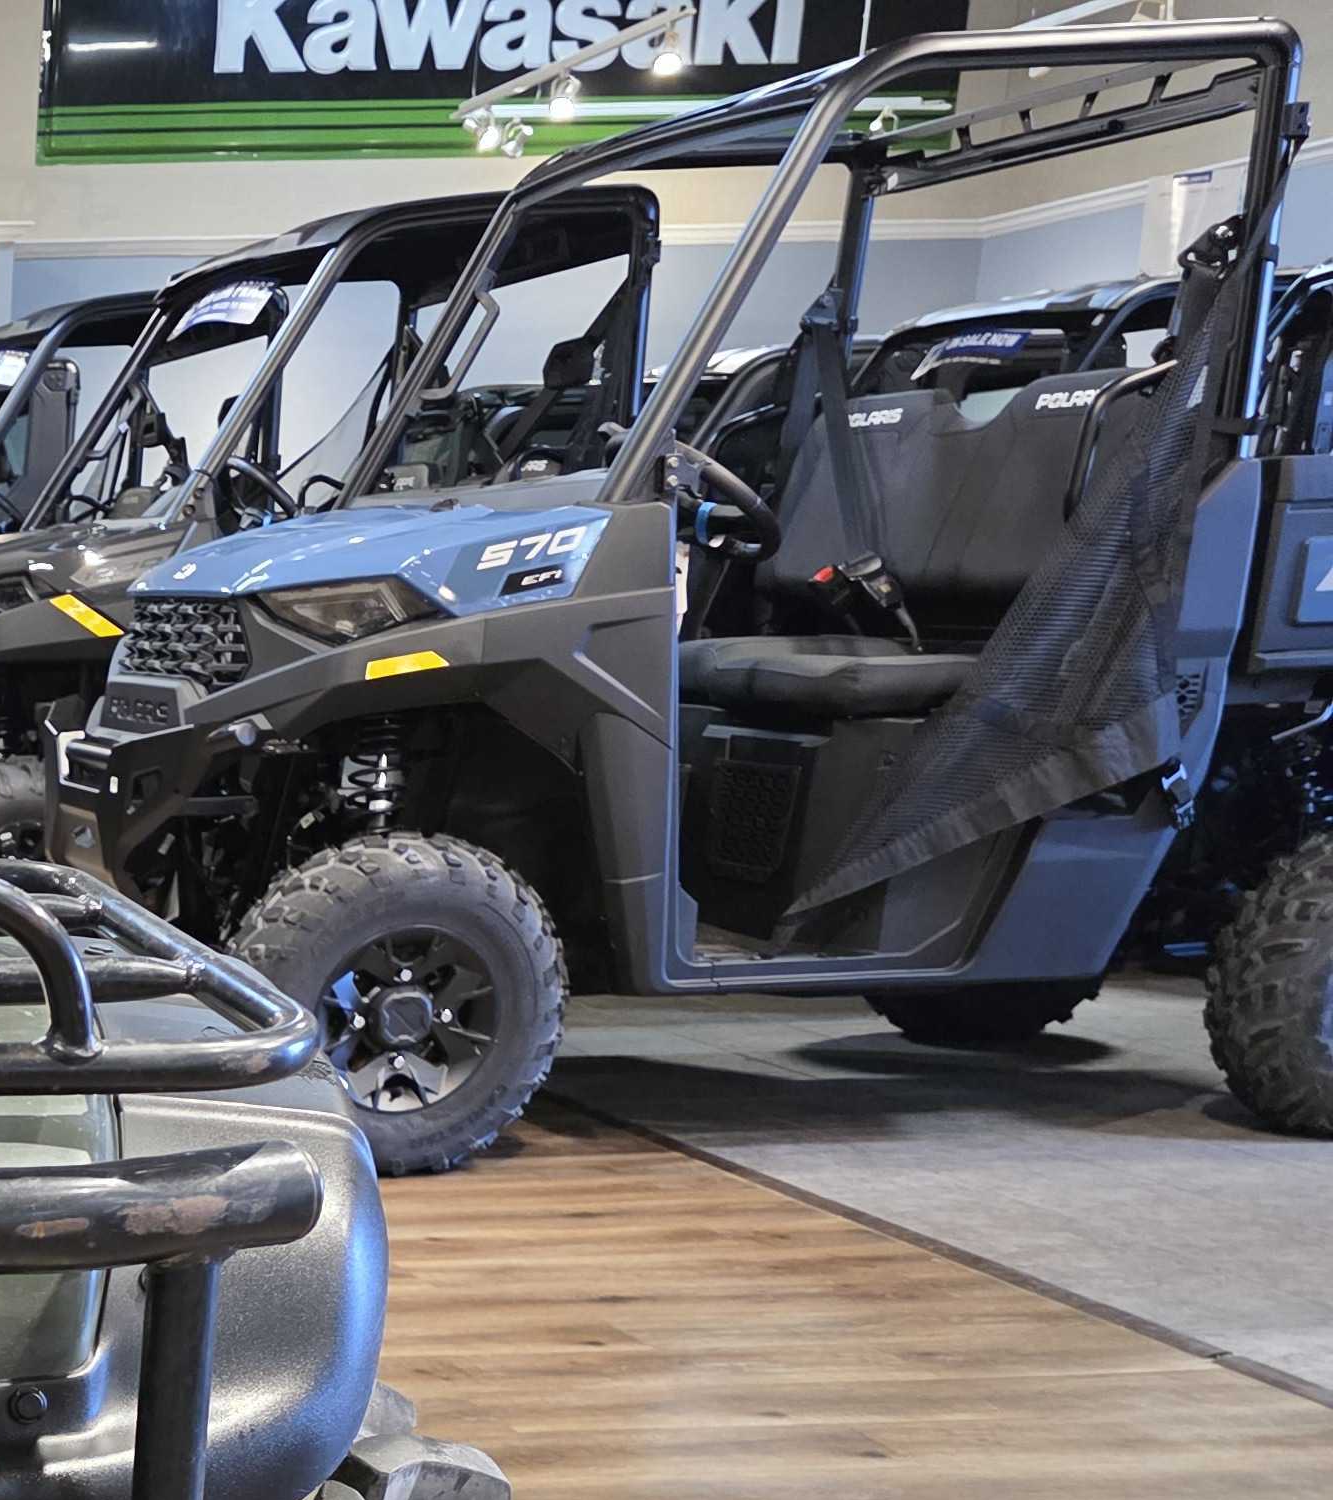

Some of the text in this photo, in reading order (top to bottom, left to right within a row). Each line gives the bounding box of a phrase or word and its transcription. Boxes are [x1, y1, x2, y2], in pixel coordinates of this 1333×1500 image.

[213, 0, 801, 74] Kawasaki
[1035, 388, 1101, 410] POLAR
[848, 408, 903, 428] OLARIS
